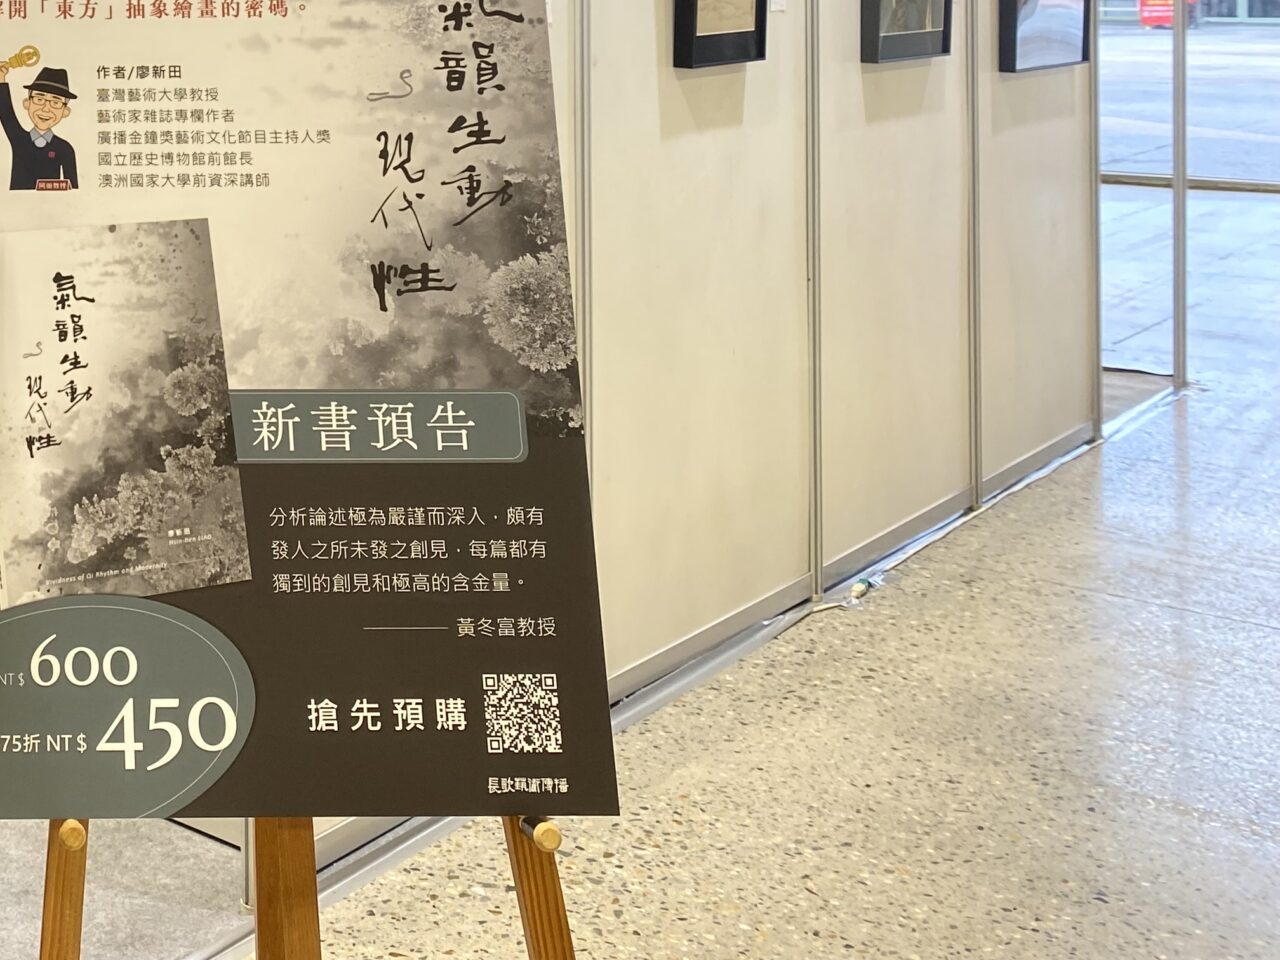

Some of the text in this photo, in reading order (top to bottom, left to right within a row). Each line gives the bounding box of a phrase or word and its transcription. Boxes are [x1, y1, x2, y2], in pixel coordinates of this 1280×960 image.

[96, 64, 183, 81] 作者/廖新田
[96, 87, 220, 103] 臺灣藝術大學教授
[96, 108, 236, 124] 藝術家雜誌專欄作者
[97, 150, 254, 167] 國立歷史博物館前館長
[98, 172, 271, 189] 澳洲國家大學前資深講師
[51, 271, 96, 414] 氣韻生動
[250, 399, 477, 453] 新書預告
[95, 569, 120, 580] Rhythm
[272, 571, 526, 594] 獨到的創見和極高的含金量。
[456, 616, 558, 638] 黃冬富教授
[29, 633, 139, 687] 600
[307, 698, 469, 732] 搶先預購
[95, 695, 238, 772] 450
